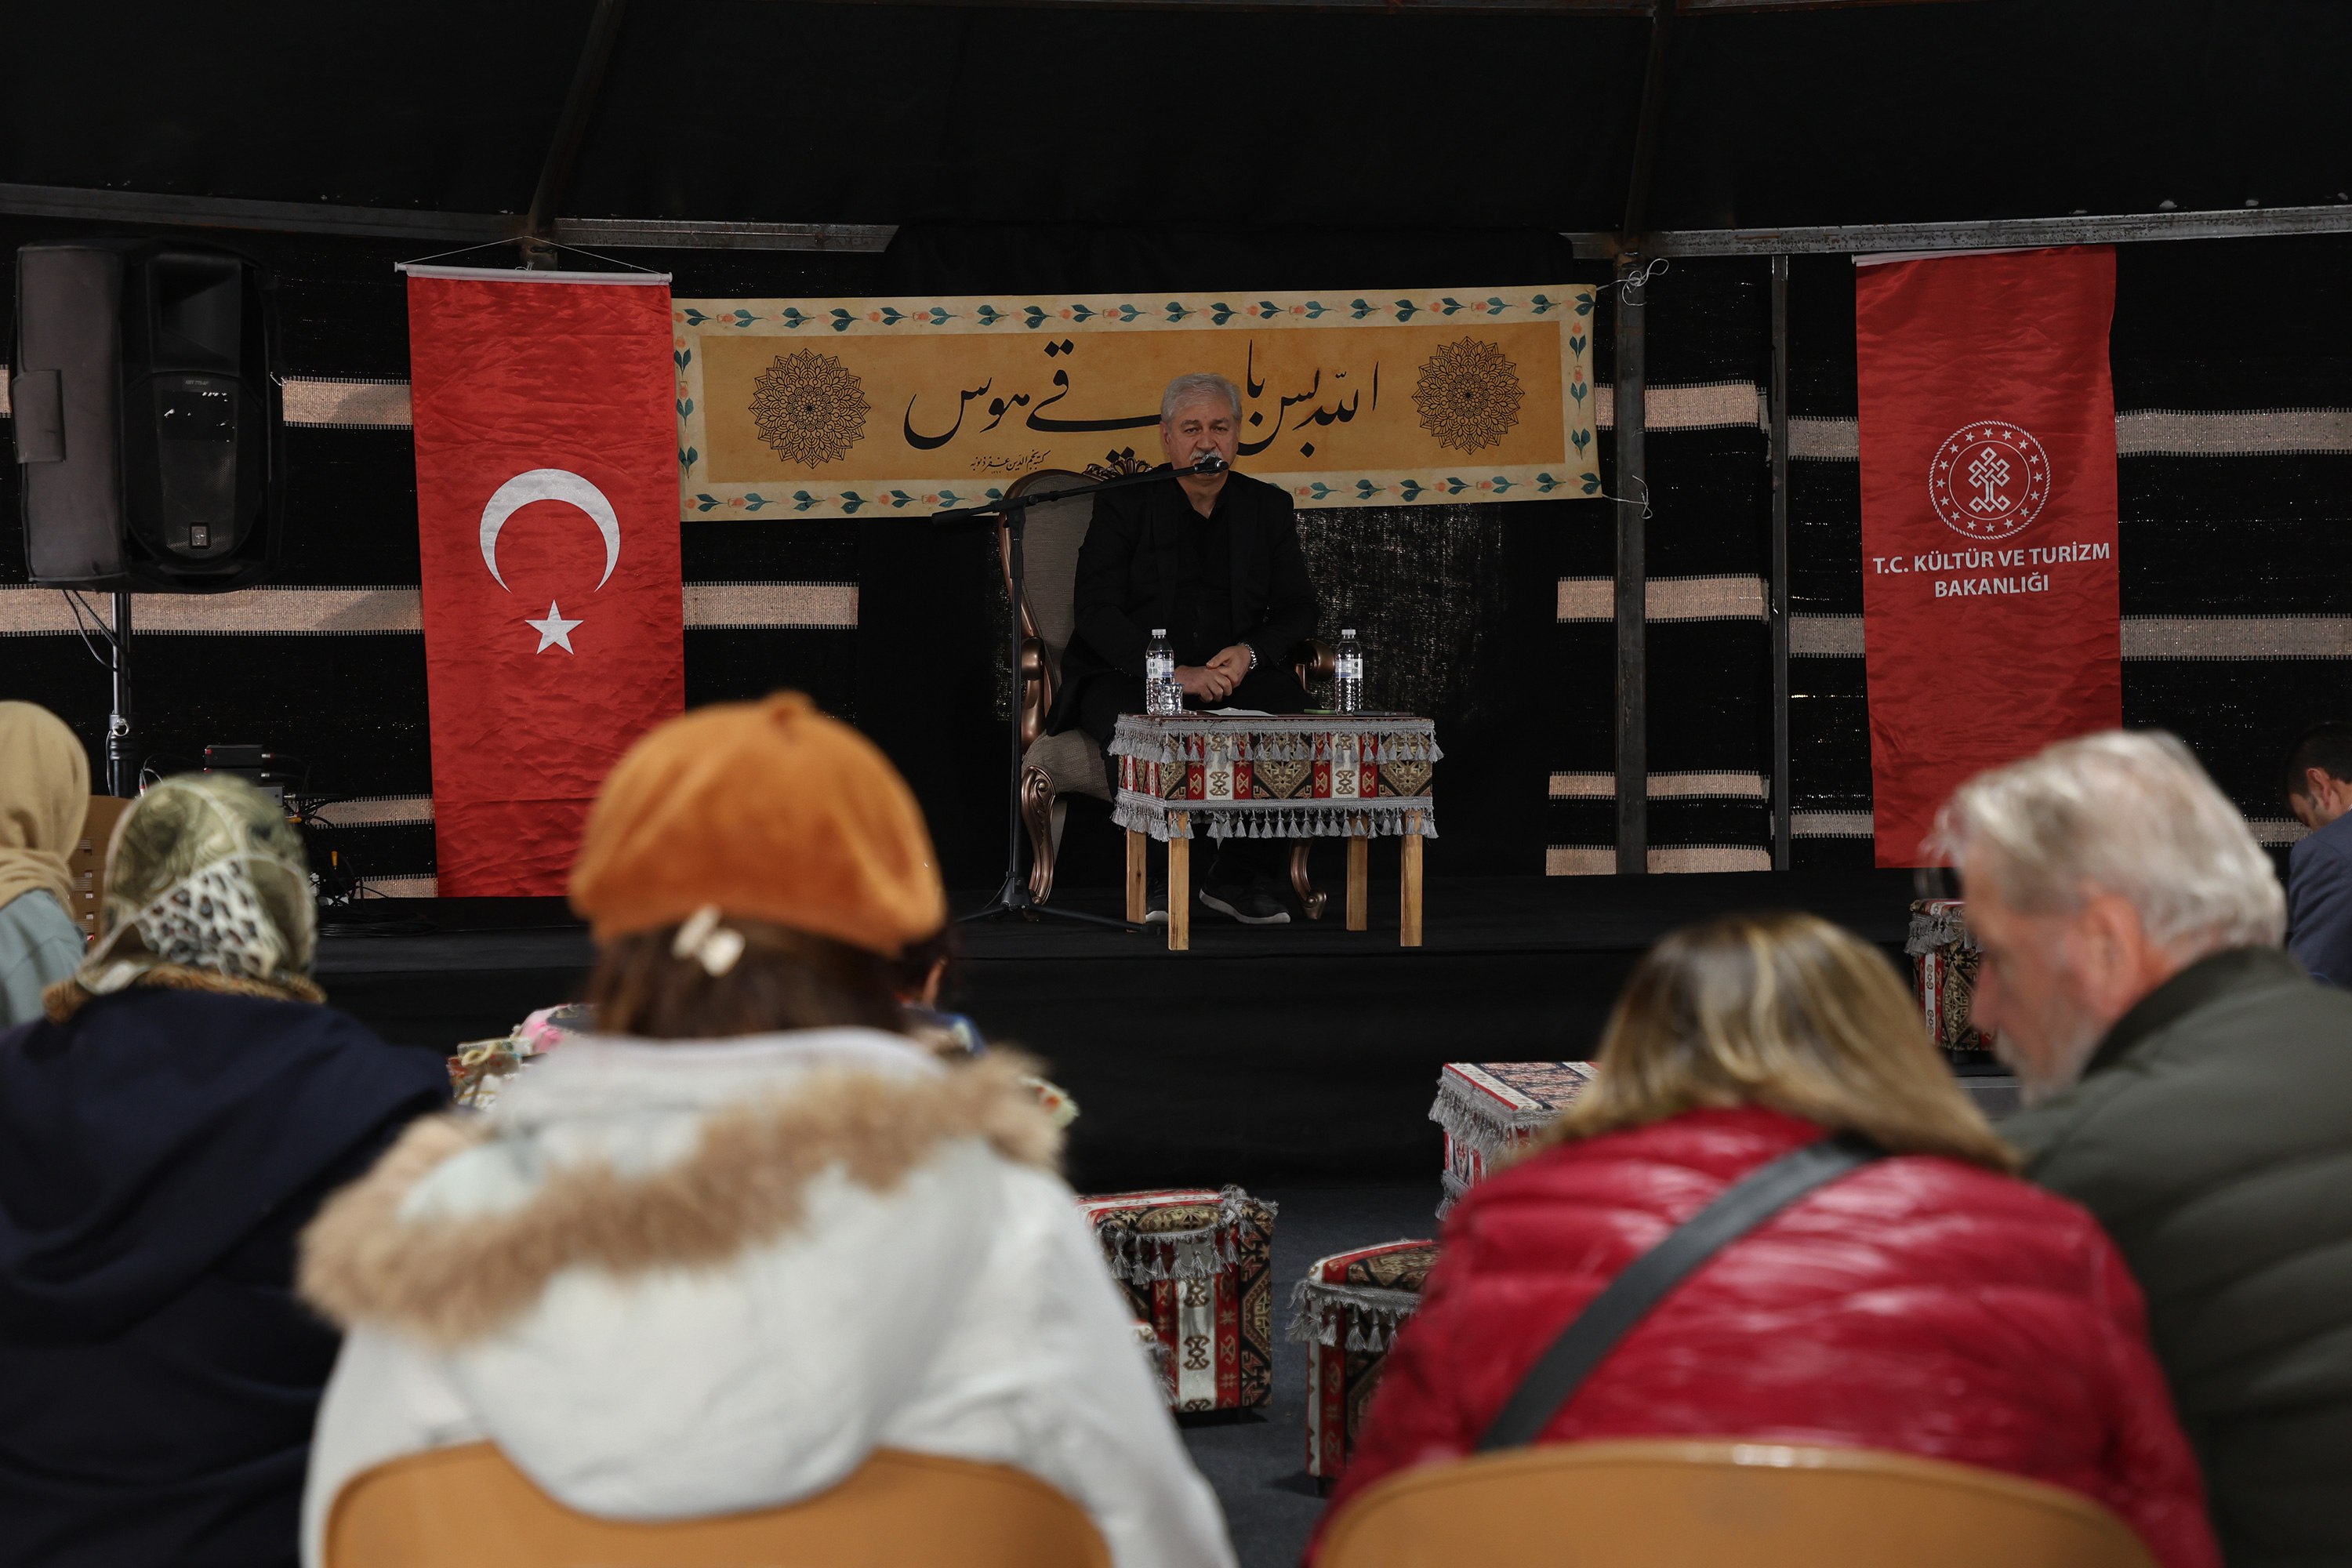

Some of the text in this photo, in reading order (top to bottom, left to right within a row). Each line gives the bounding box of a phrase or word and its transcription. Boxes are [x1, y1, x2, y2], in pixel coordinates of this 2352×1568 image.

[1872, 541, 2110, 574] T.C. KÜLTÜR VE TURİZM
[1934, 572, 2049, 597] BAKANLIĞI
